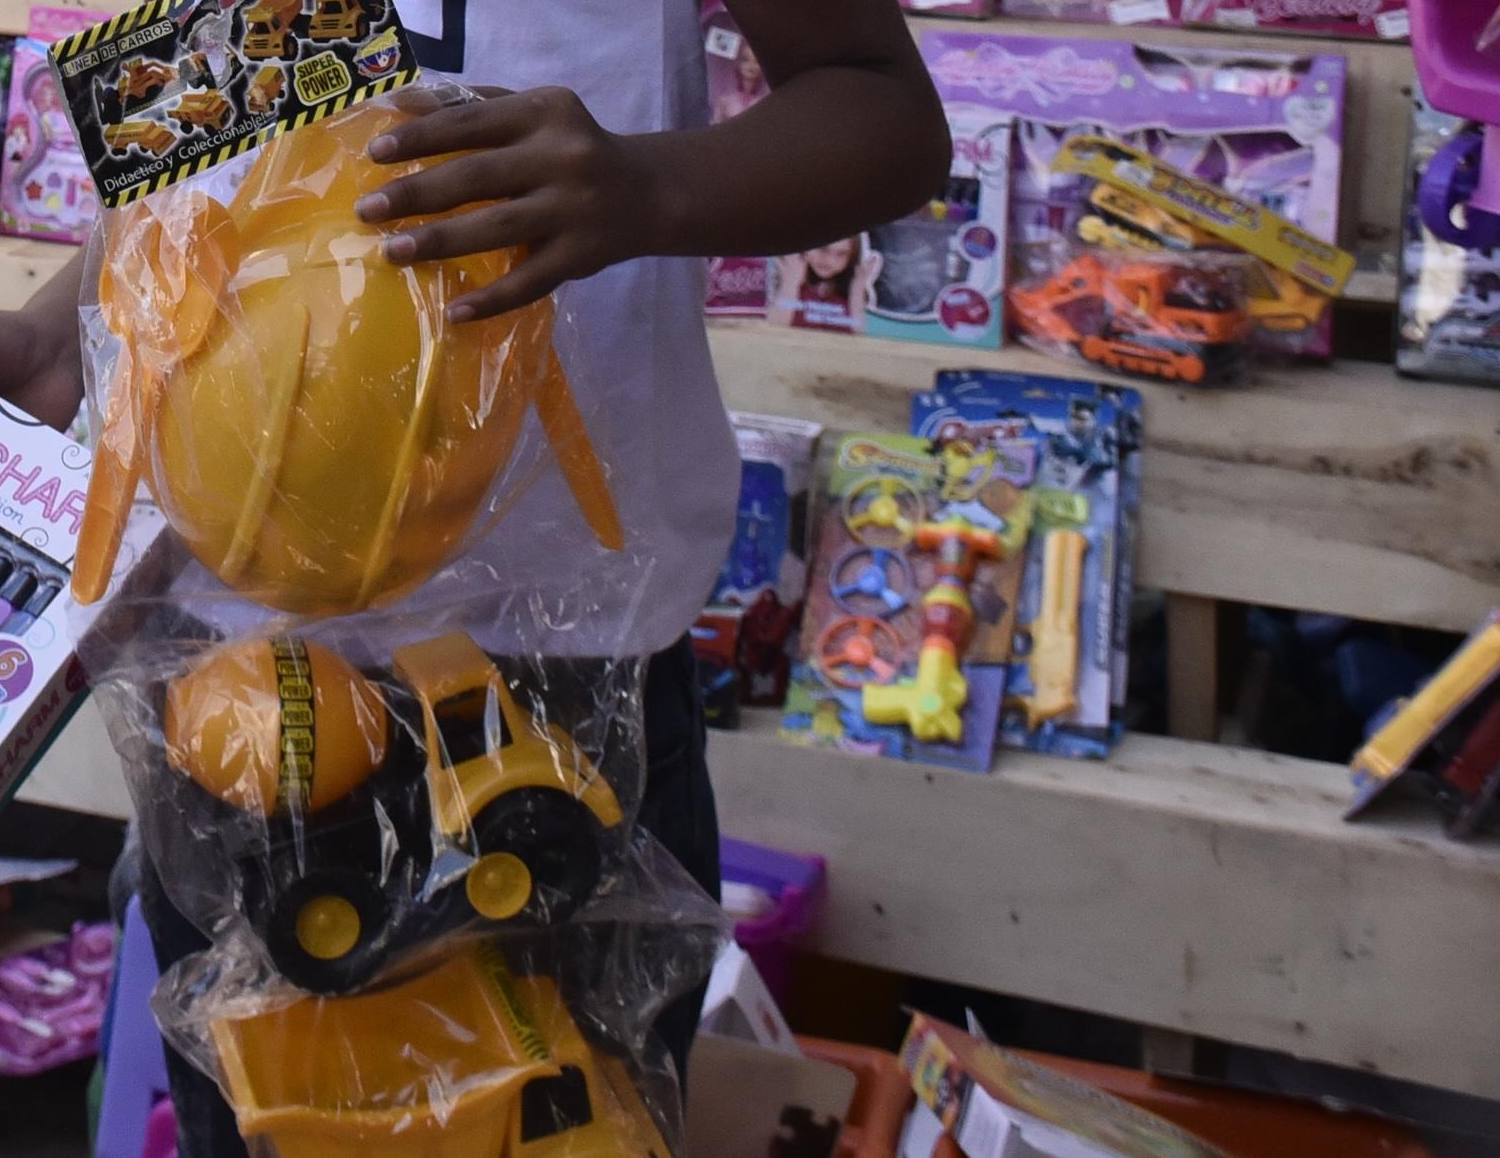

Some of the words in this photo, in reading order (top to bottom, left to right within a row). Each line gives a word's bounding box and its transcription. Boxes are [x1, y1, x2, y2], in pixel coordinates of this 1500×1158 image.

[63, 50, 101, 77] LINEA
[100, 43, 117, 61] DE
[117, 20, 174, 52] CARROS
[298, 54, 337, 77] SUPER
[301, 73, 347, 101] POWER
[103, 160, 165, 194] Didactico
[165, 156, 175, 171] y
[177, 112, 268, 160] Coleccionable!
